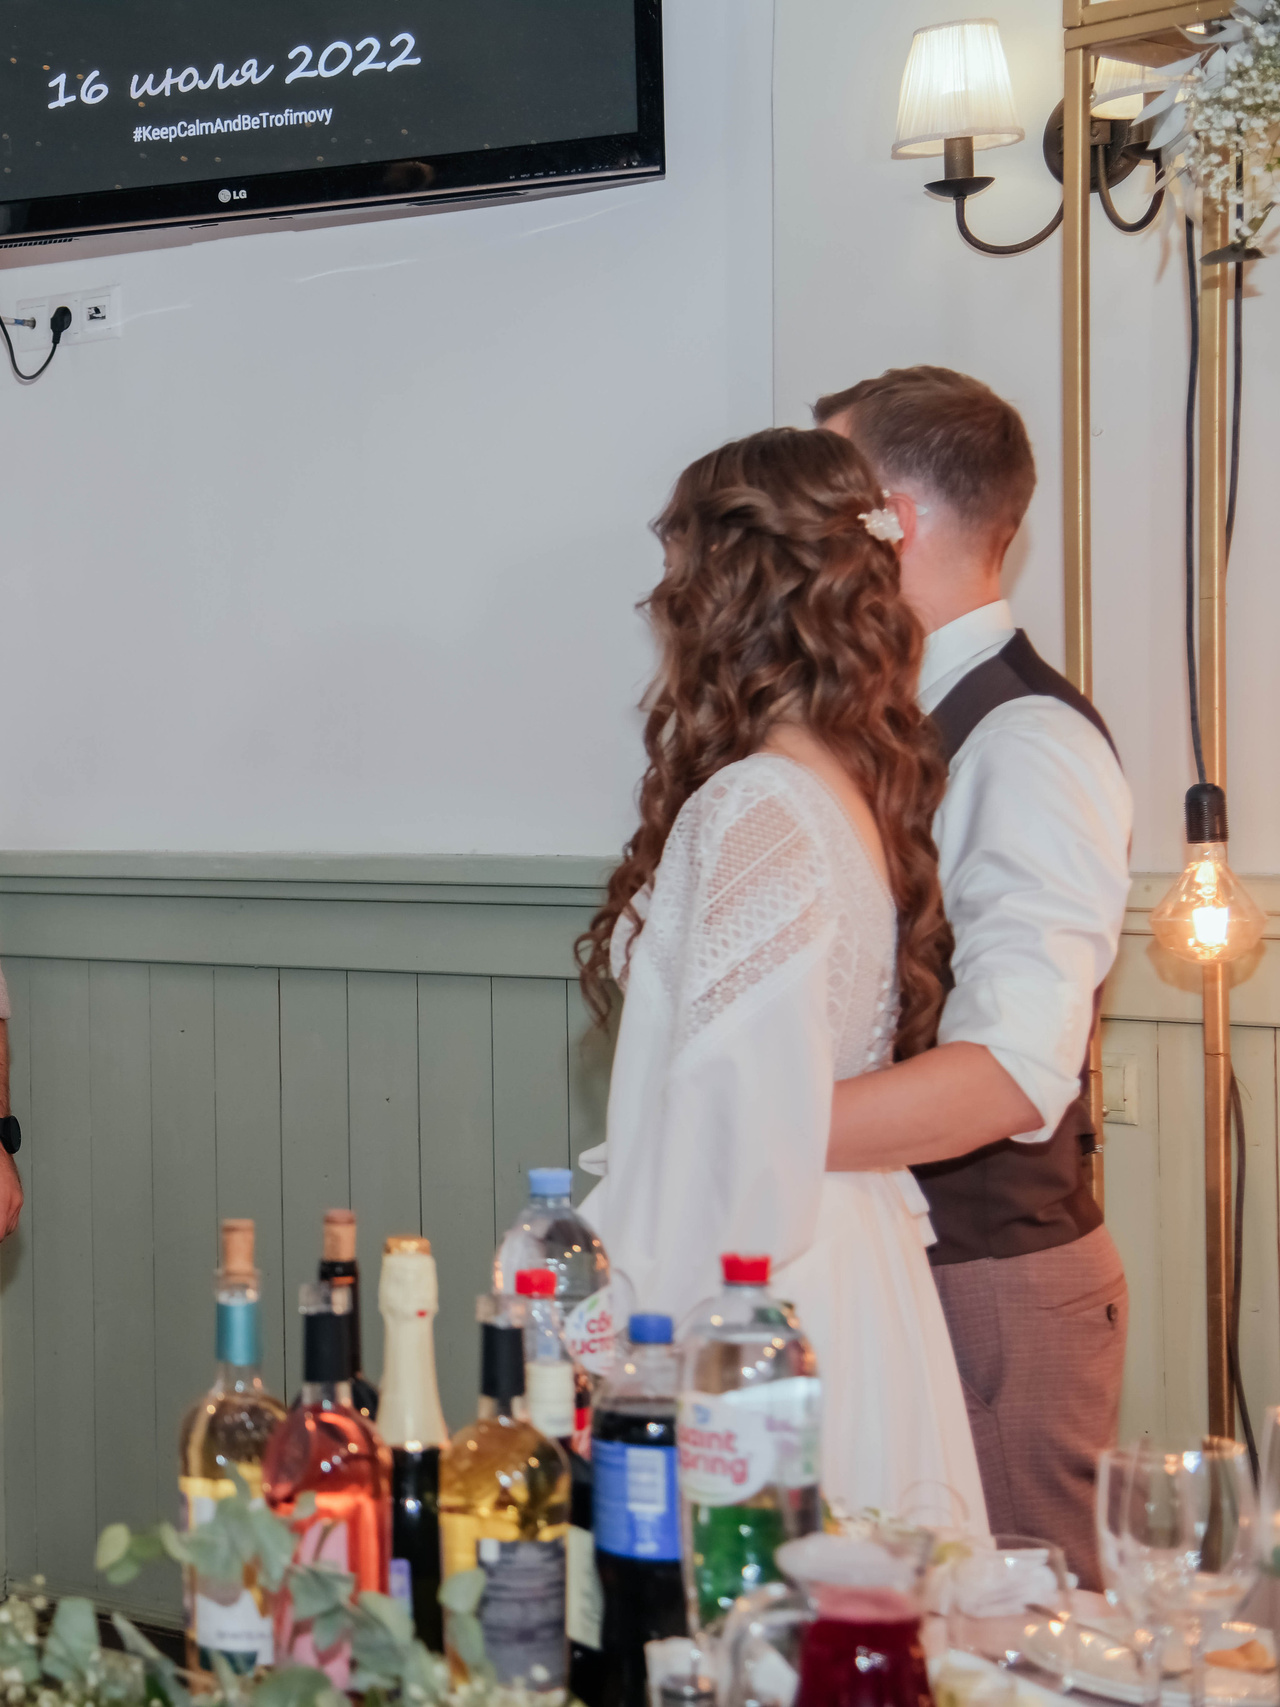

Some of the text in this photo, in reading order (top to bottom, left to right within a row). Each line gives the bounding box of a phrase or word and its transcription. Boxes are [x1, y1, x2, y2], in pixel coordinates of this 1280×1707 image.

[47, 32, 422, 109] 16 июля 2022
[132, 107, 333, 142] #KeepCalmAndBeTrofimovy
[232, 190, 248, 200] LG
